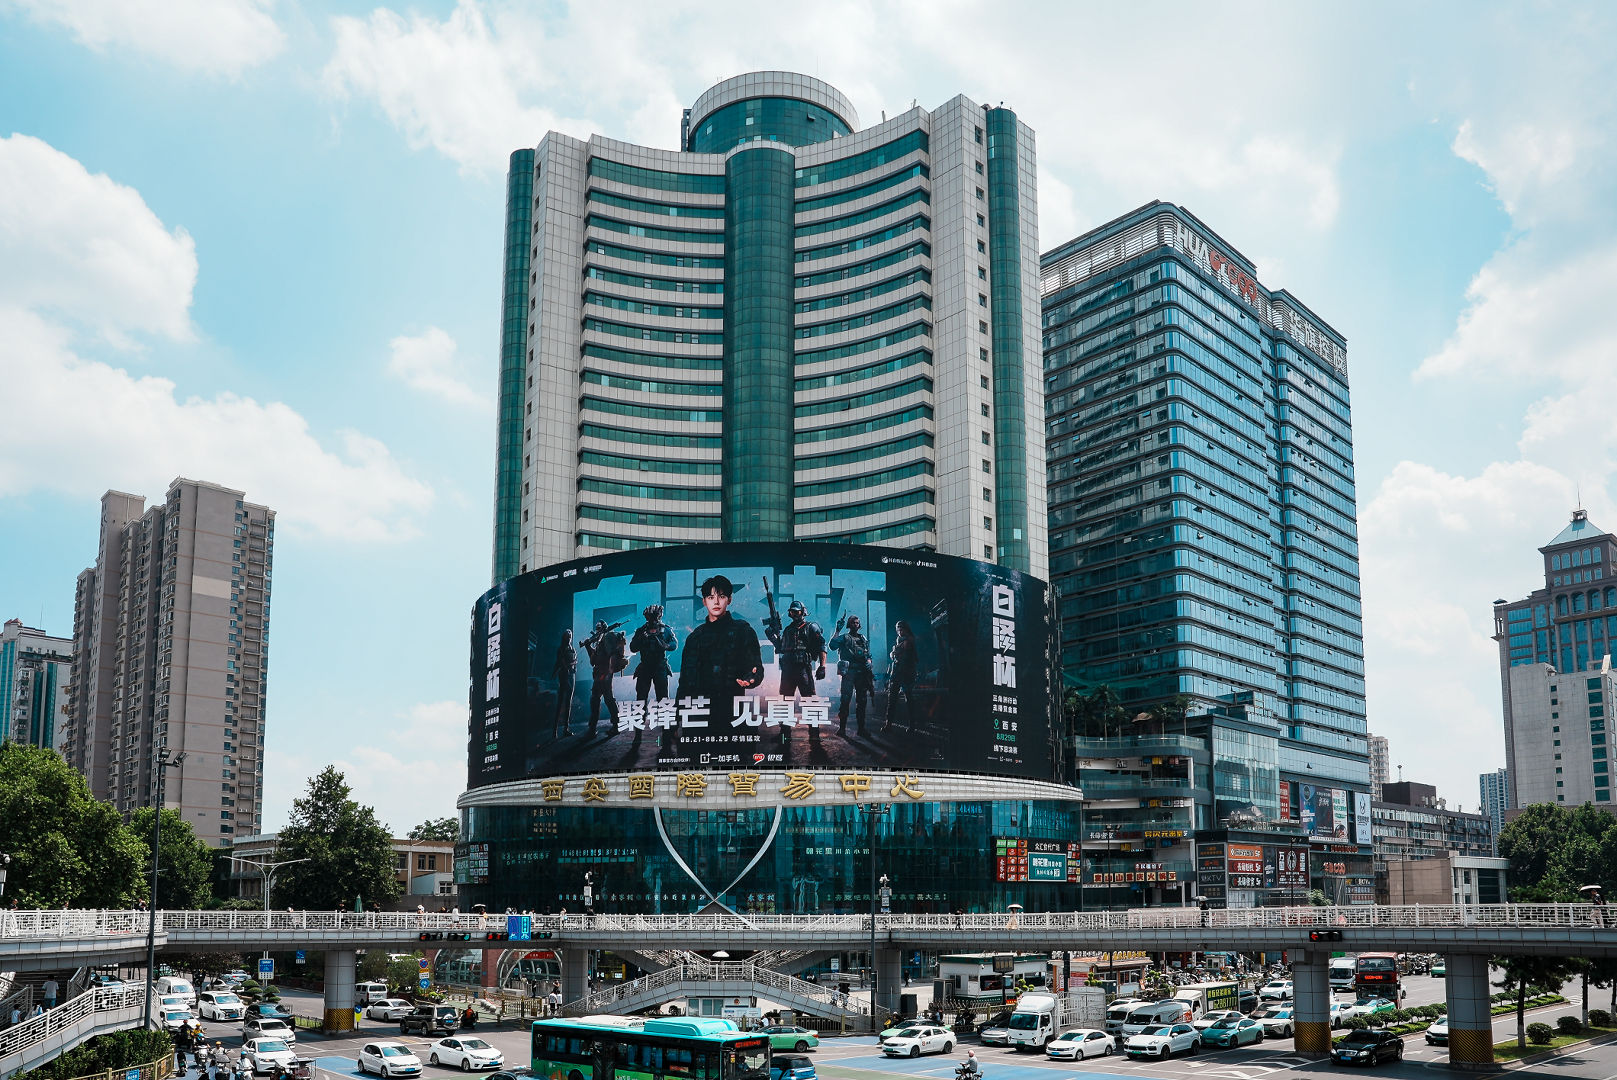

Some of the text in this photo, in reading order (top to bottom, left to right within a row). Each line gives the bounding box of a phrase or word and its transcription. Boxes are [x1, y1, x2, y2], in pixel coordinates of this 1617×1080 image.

[616, 695, 832, 732] 聚锋芒 见真章
[1001, 720, 1018, 731] 西安
[710, 754, 740, 762] 一加手机
